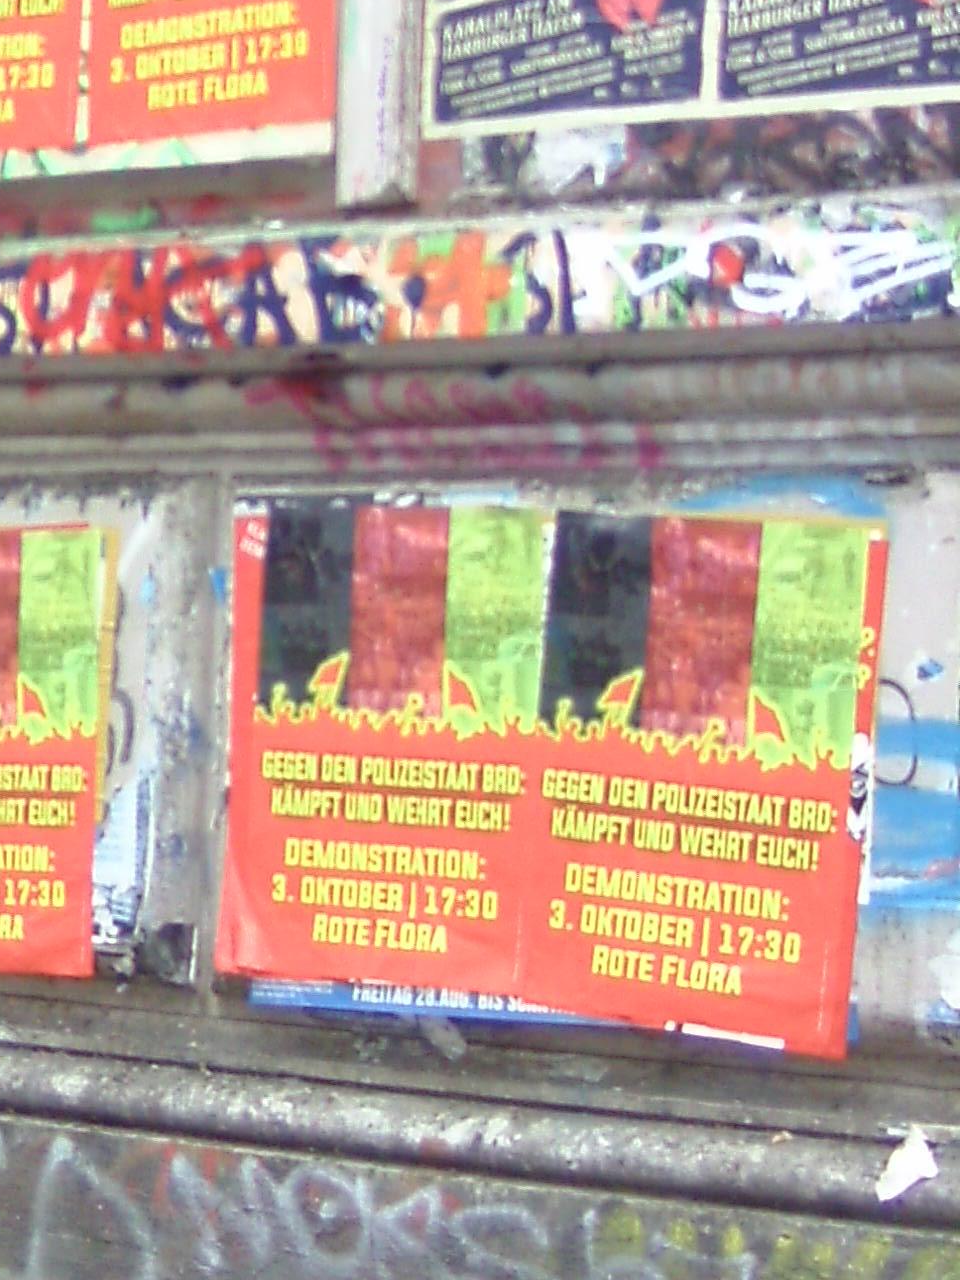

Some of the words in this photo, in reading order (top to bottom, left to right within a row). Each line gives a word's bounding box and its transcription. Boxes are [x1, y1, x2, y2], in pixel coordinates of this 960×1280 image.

[51, 765, 87, 792] BRD:
[262, 751, 318, 781] GEGEN
[321, 754, 357, 784] DEN
[361, 757, 479, 791] POLIZEISTAAT
[482, 764, 525, 794] BRD:
[28, 798, 75, 826] EUCH!
[271, 784, 342, 818] KÄMPFT
[345, 793, 383, 822] UND
[387, 796, 452, 826] WEHRT
[455, 799, 511, 831] EUCH!
[542, 768, 605, 804] GEGEN
[608, 776, 649, 810] DEN
[652, 782, 784, 825] POLIZEISTAAT
[788, 798, 838, 833] BRD:
[285, 838, 485, 880] DEMONSTRATION:
[551, 805, 630, 845] KÄMPFT
[633, 819, 675, 852] UND
[680, 825, 753, 861] WEHRT
[756, 834, 819, 871] EUCH!
[4, 879, 65, 908] 17:30
[272, 873, 294, 902] 3.
[300, 876, 404, 912] OKTOBER
[424, 885, 498, 920] 17:30
[566, 863, 788, 920] DEMONSTRATION:
[312, 913, 370, 946] ROTE
[374, 918, 448, 953] FLORA
[549, 899, 573, 930] 3.
[580, 904, 694, 948] OKTOBER
[719, 923, 801, 963] 17:30
[591, 944, 655, 982] ROTE
[660, 955, 742, 995] FLORA
[352, 984, 413, 1008] FREITAG
